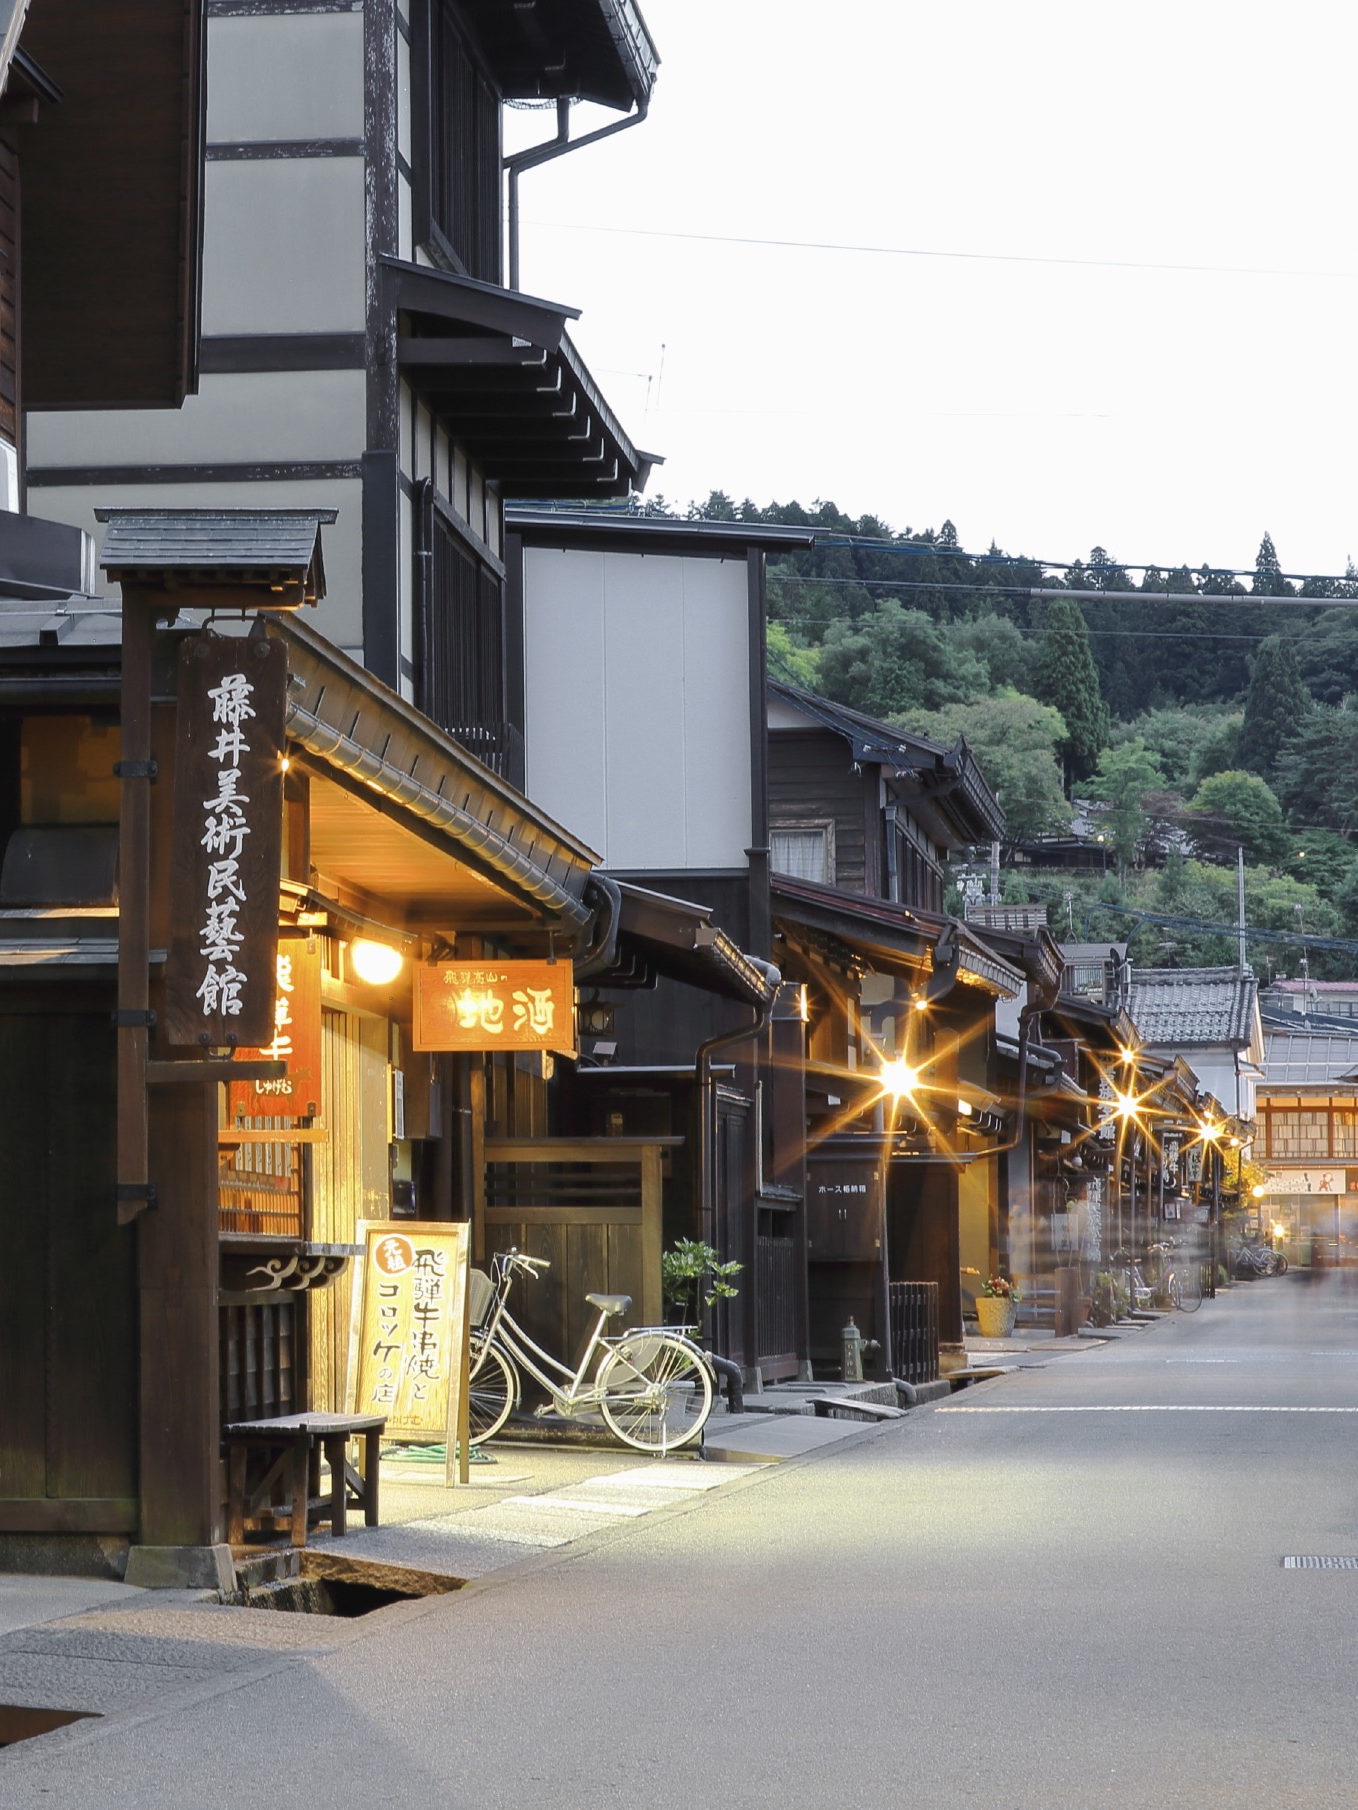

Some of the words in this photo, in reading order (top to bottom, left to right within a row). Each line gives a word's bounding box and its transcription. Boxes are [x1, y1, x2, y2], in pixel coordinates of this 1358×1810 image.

[196, 673, 256, 1016] 藤井美術民藝館
[457, 987, 555, 1034] 地酒
[371, 1283, 402, 1402] コロッケの店
